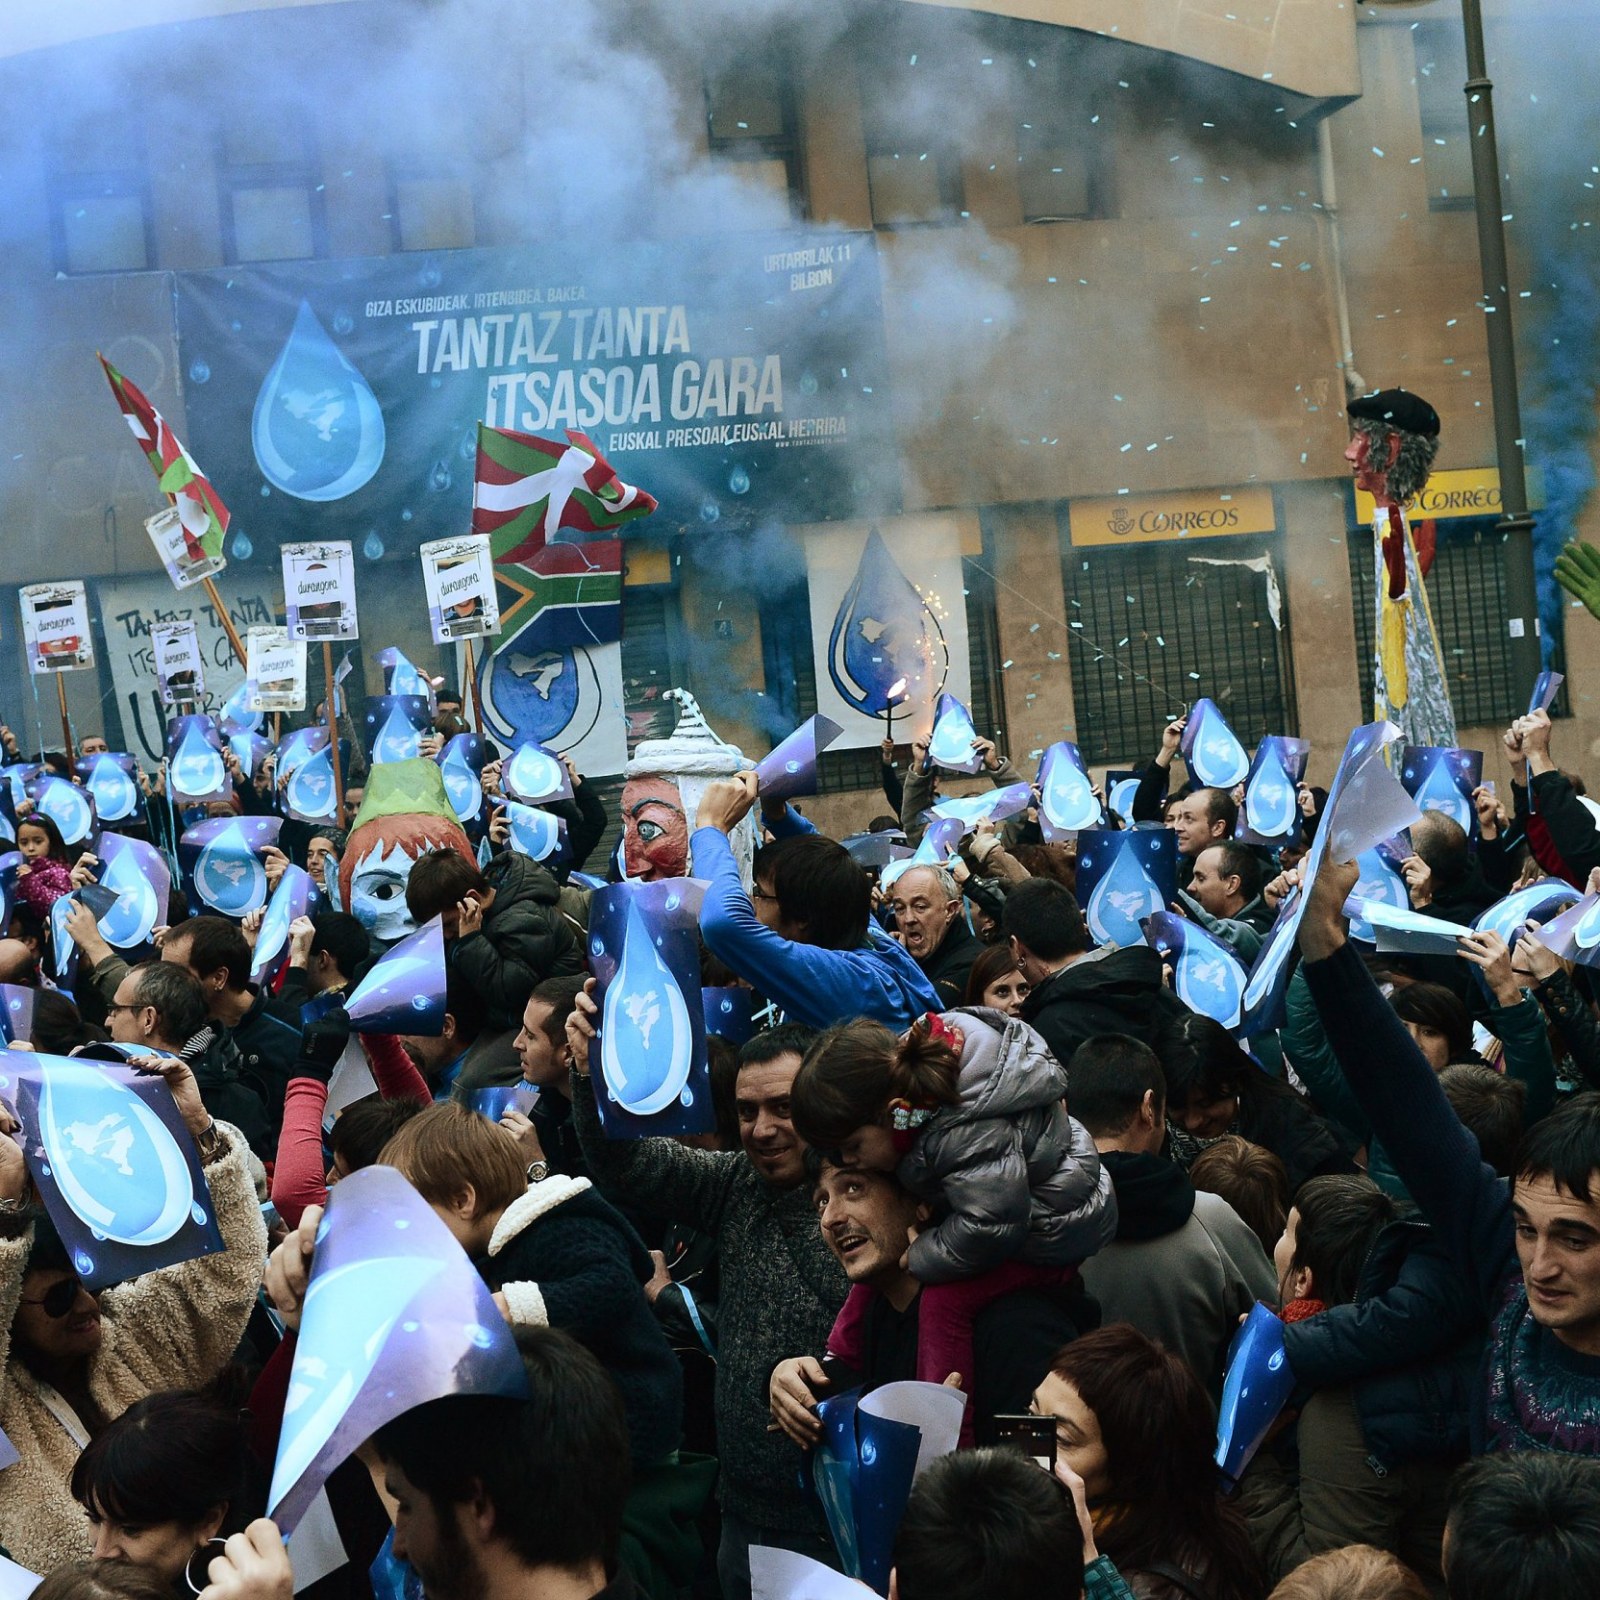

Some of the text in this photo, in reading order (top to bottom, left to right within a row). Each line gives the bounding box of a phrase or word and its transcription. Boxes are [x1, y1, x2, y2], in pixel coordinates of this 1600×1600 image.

[764, 244, 850, 272] URTARRILAK 11
[790, 268, 833, 291] BILBON
[365, 301, 392, 317] GIZA
[395, 294, 471, 315] ESKUBIDEAK.
[412, 305, 691, 374] TANTAZ TANTA
[485, 355, 783, 431] ITSASOA GARA
[609, 431, 662, 452] EUSKAL
[666, 425, 730, 448] PRESOAK
[733, 421, 785, 442] EUSKAL
[1420, 487, 1501, 512] CORREO
[1139, 507, 1239, 534] CORREOS
[199, 595, 271, 628] TNTA
